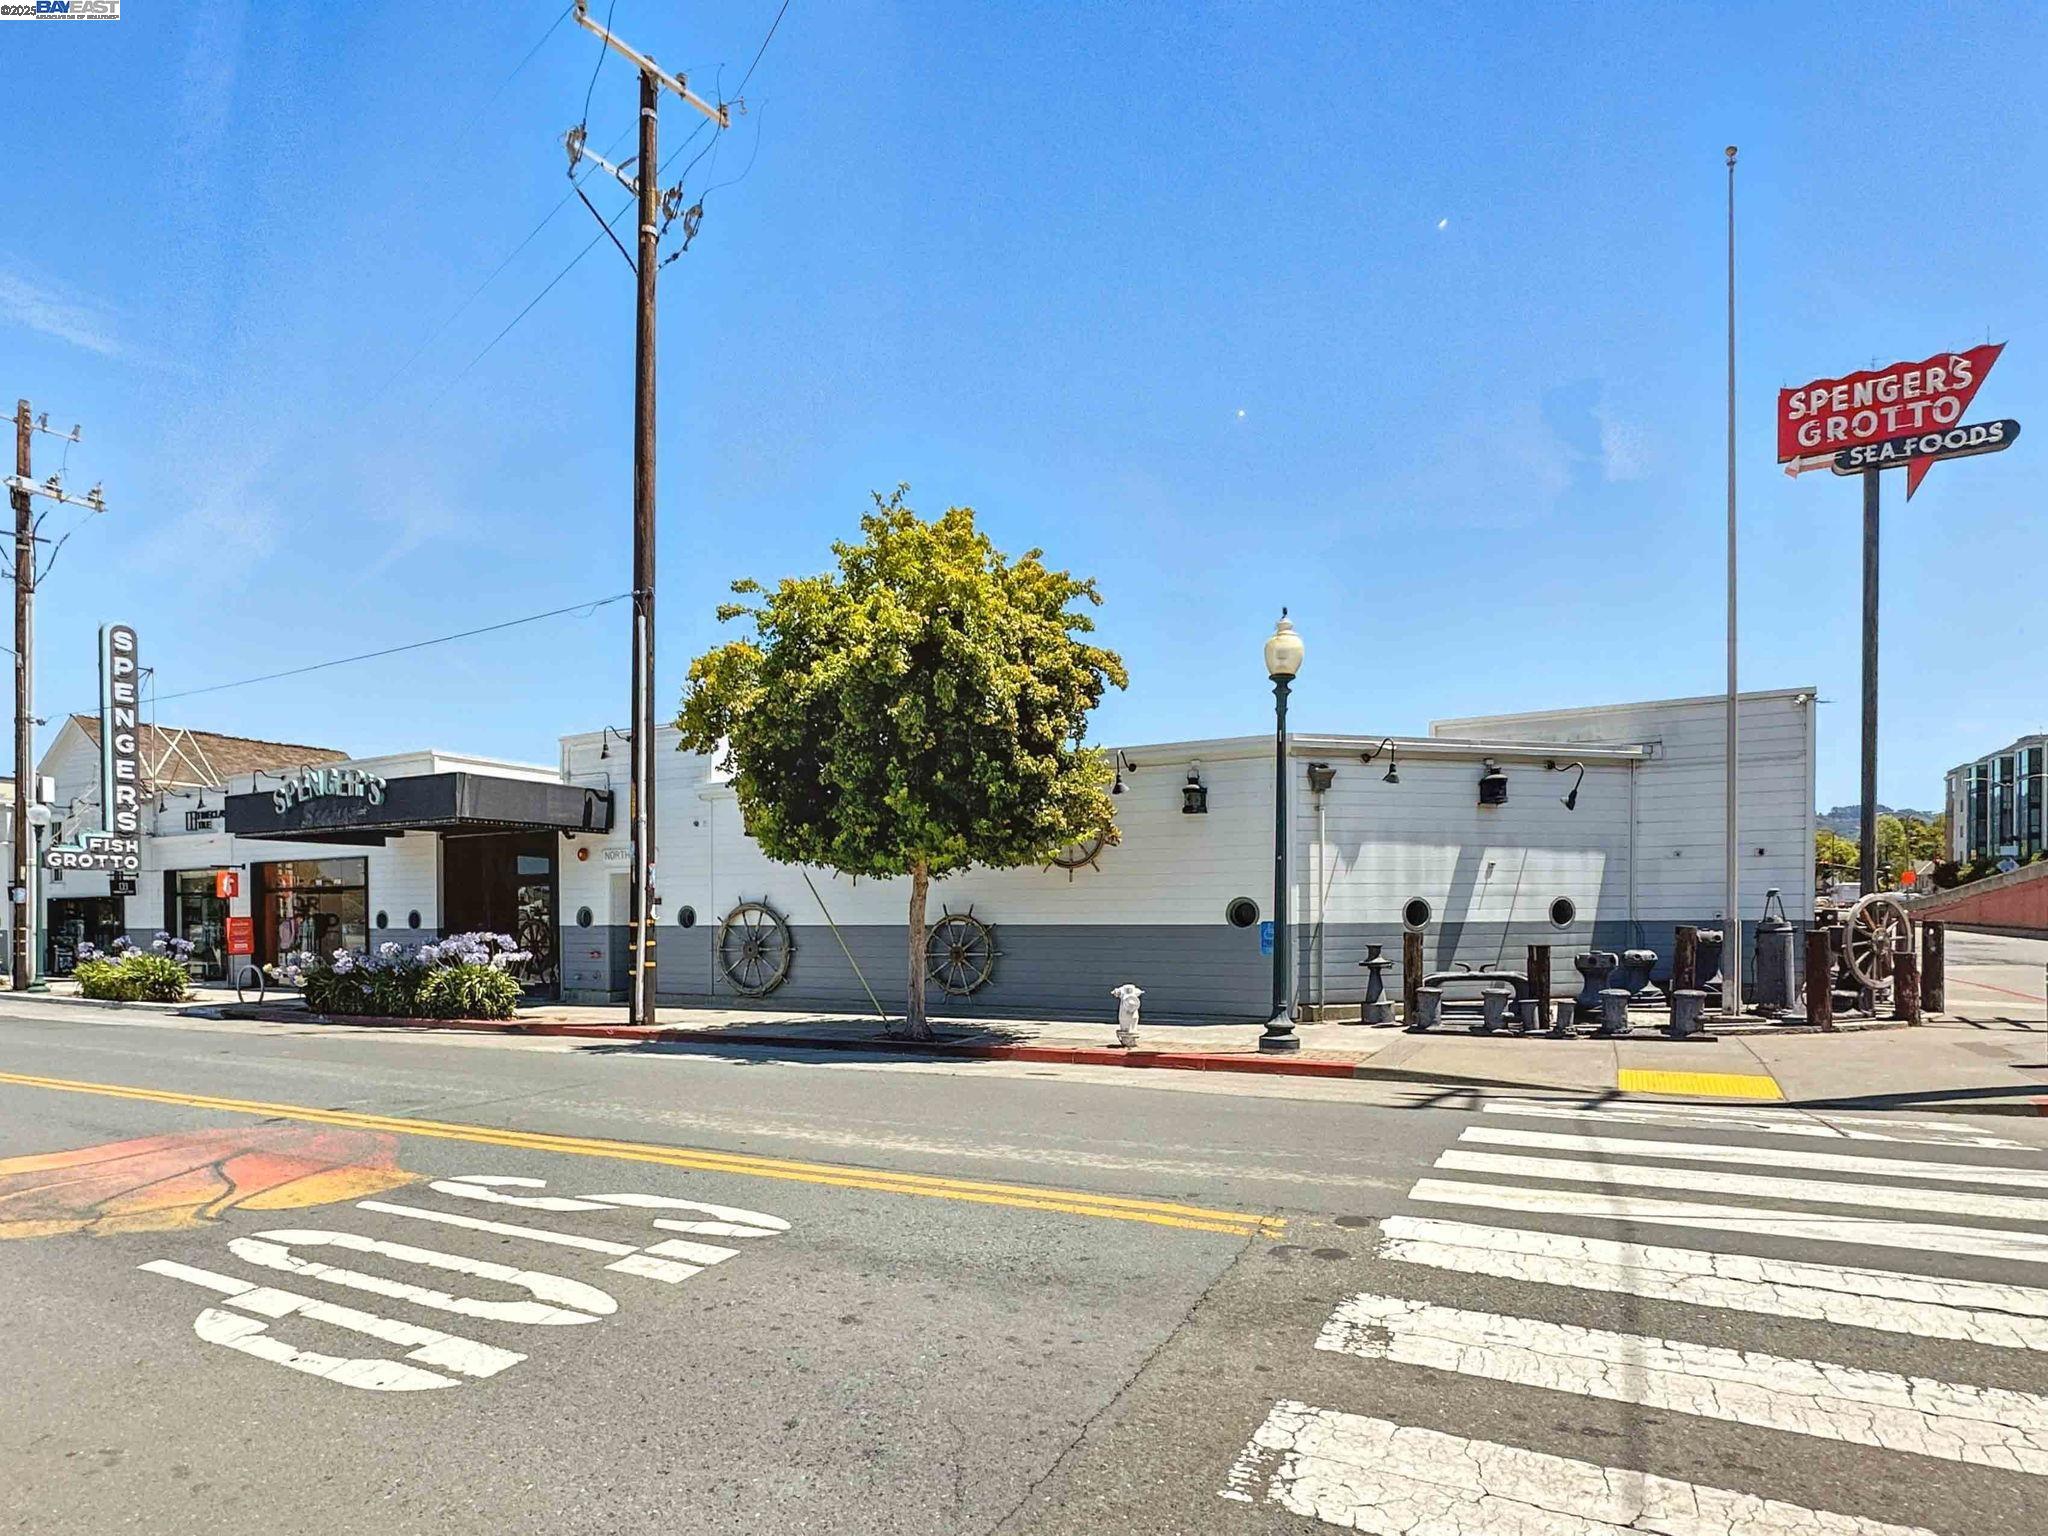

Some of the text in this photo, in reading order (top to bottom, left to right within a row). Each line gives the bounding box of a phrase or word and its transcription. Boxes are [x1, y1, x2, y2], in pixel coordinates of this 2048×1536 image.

[1788, 355, 1974, 420] SPENGER'S
[1797, 396, 1961, 447] GROTTO
[1849, 421, 2005, 466] SEA FOODS
[113, 631, 138, 832] SPENGER'S
[273, 768, 386, 814] SPENGER'S
[47, 853, 139, 869] GROTTO
[89, 838, 139, 853] FISH
[137, 1174, 792, 1392] STOP
